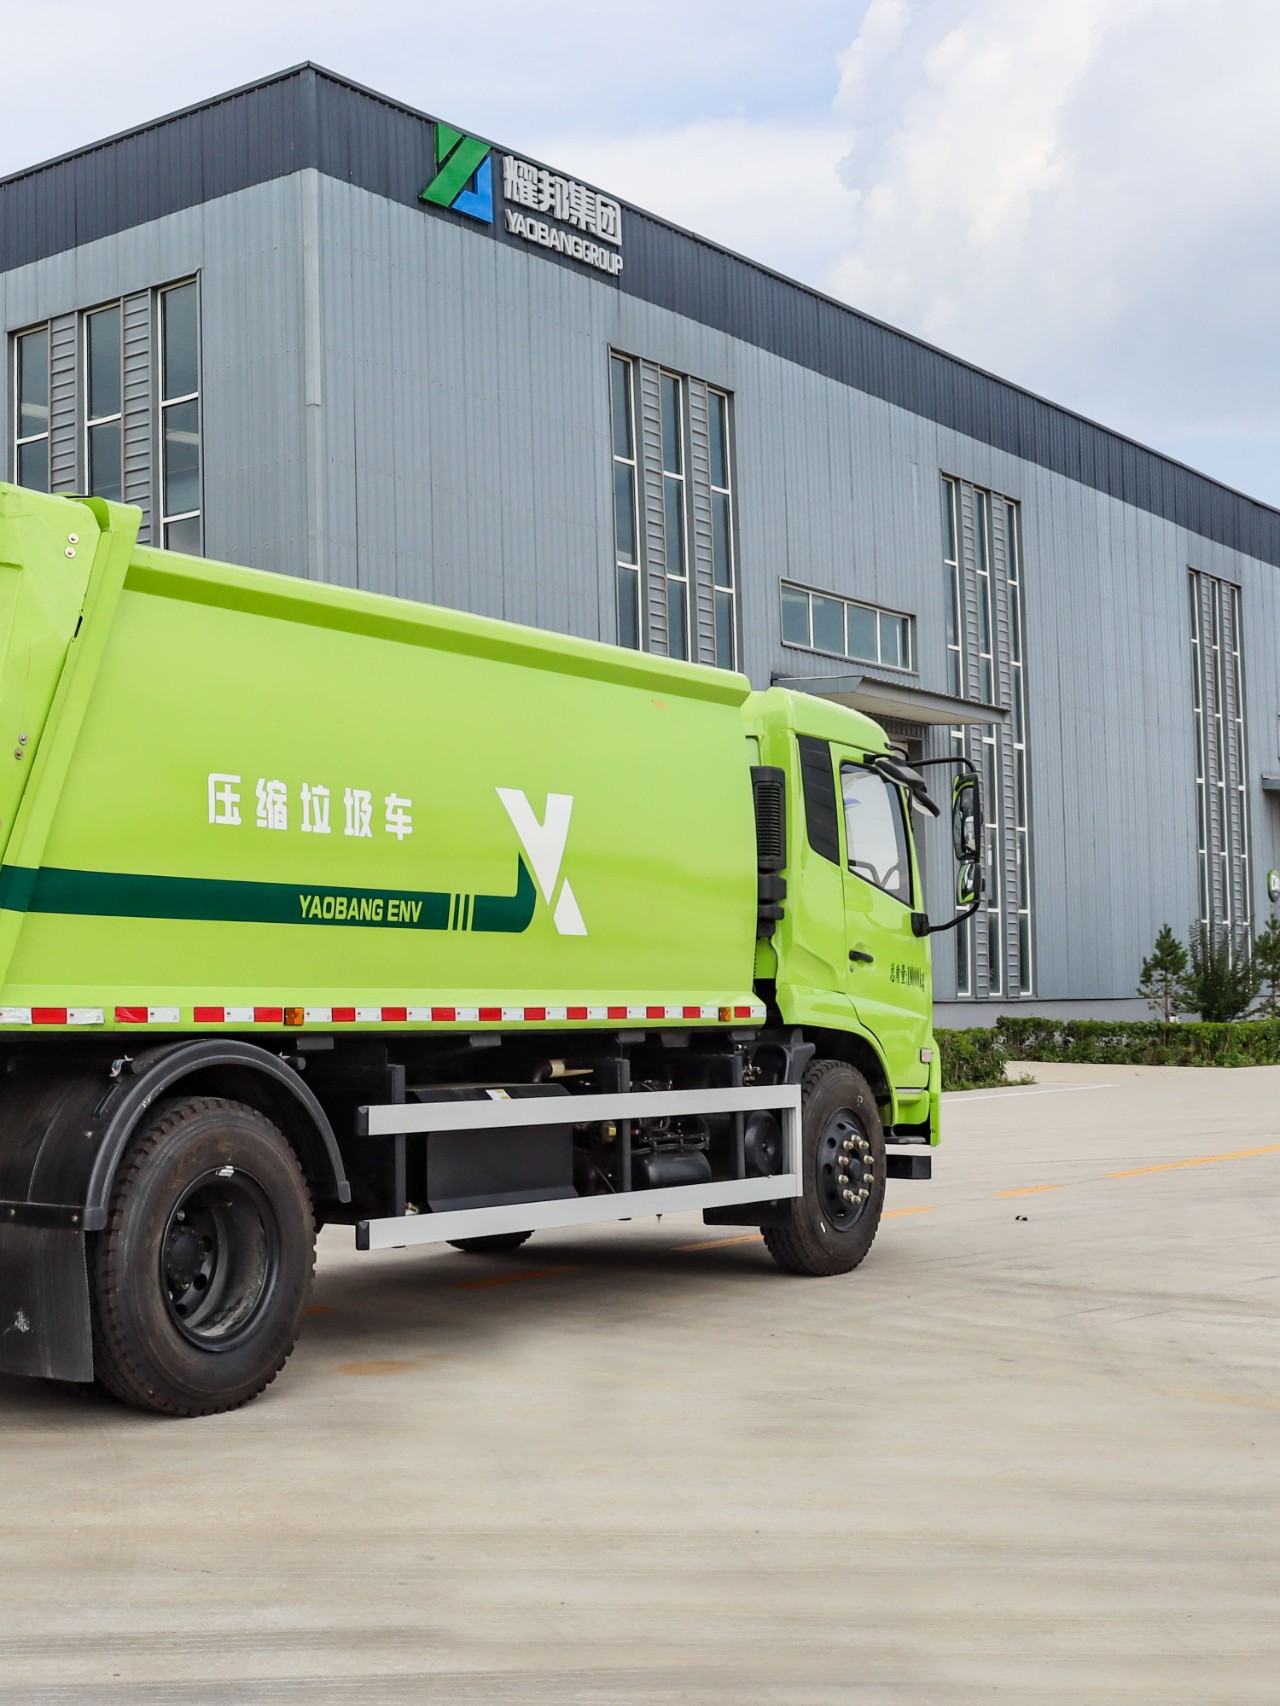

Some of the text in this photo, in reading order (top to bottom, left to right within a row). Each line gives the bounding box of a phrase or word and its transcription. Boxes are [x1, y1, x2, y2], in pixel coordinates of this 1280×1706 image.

[503, 155, 622, 246] 耀邦集团
[505, 208, 623, 276] YAOBANGGROUP
[208, 772, 413, 841] 压缩垃圾车
[299, 894, 423, 923] YAOBANG ENV
